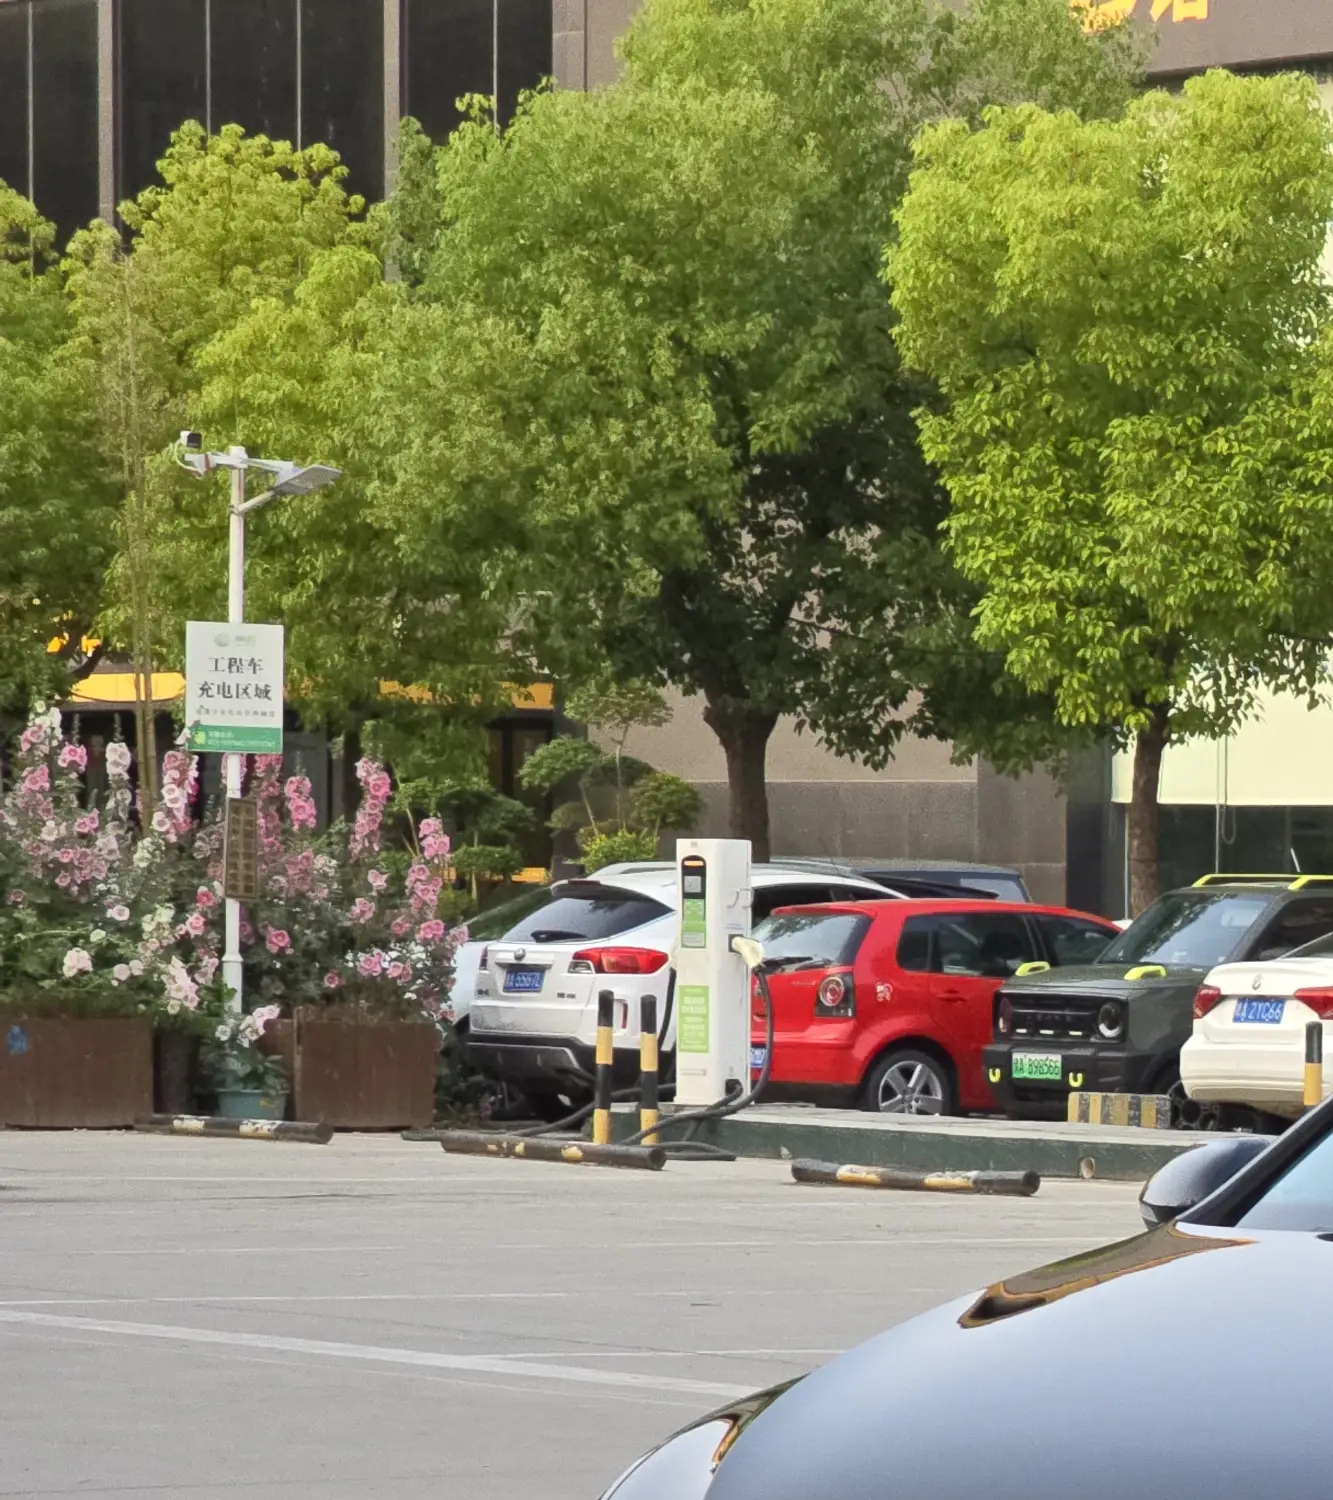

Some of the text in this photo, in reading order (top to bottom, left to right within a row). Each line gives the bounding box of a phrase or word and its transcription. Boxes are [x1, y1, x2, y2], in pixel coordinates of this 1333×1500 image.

[208, 657, 264, 675] 工程车
[198, 680, 272, 701] 充电区域
